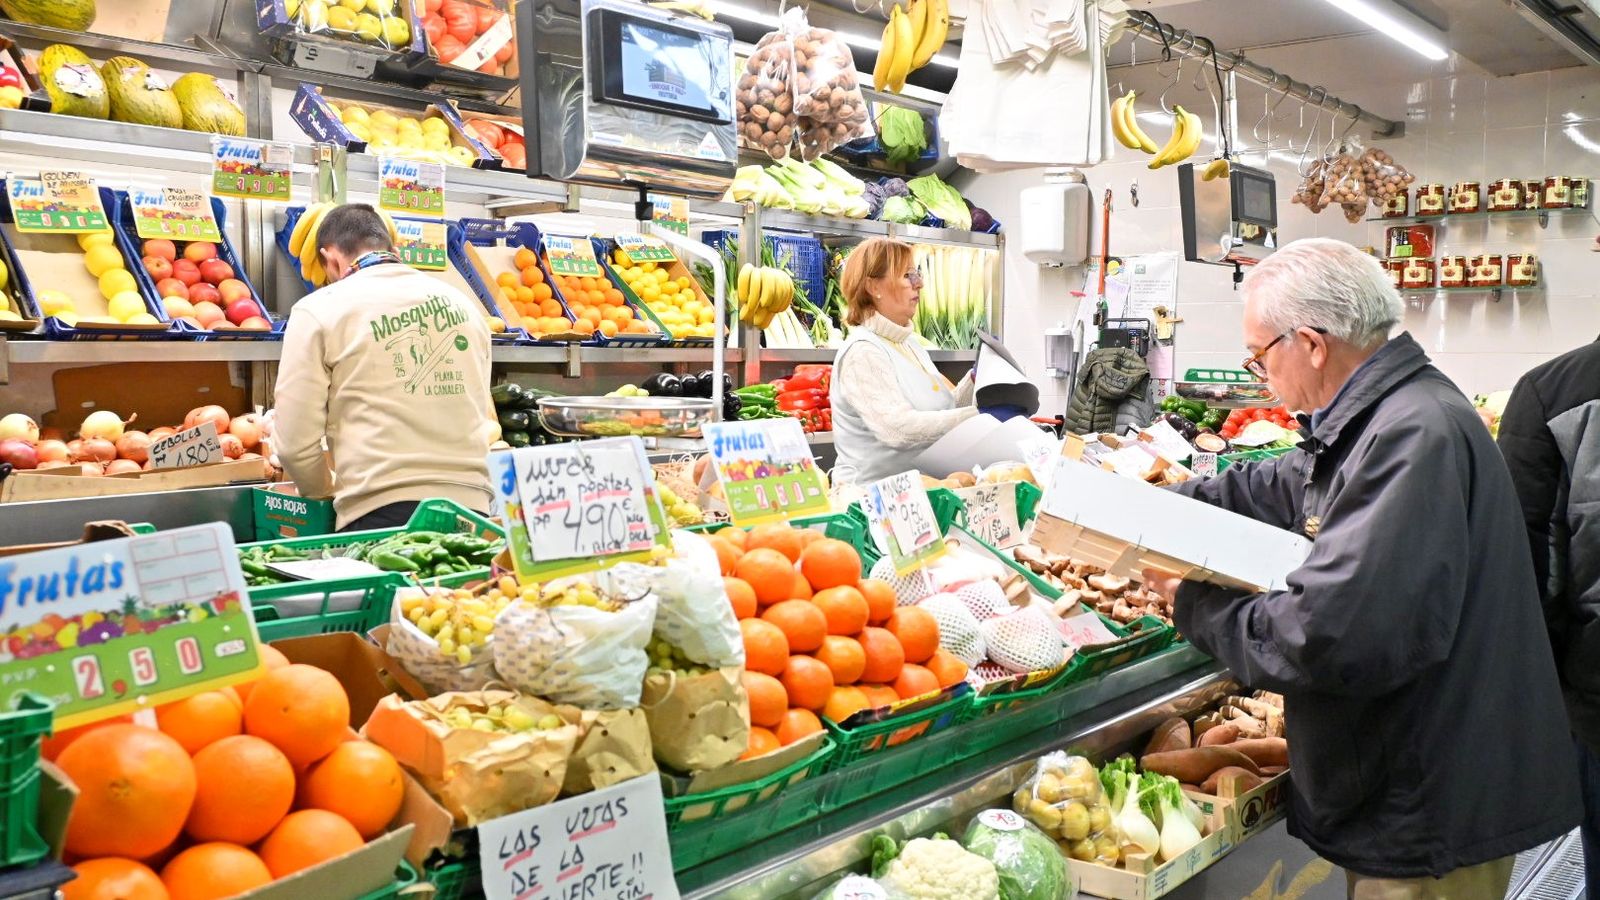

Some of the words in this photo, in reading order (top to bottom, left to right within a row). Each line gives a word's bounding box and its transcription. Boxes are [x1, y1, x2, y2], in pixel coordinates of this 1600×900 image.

[217, 141, 260, 159] Frutas
[382, 160, 418, 177] Frutas
[370, 295, 451, 342] Mosquito
[433, 304, 469, 332] Club
[393, 353, 403, 363] 20
[395, 367, 406, 378] 25
[434, 371, 454, 382] PLAYA
[456, 371, 464, 381] DE
[424, 386, 433, 396] LA
[712, 425, 765, 458] Frutas
[264, 495, 282, 510] AJOS
[499, 825, 541, 859] LAS
[565, 797, 628, 834] UVAS
[511, 866, 541, 894] DE
[559, 844, 584, 871] LA
